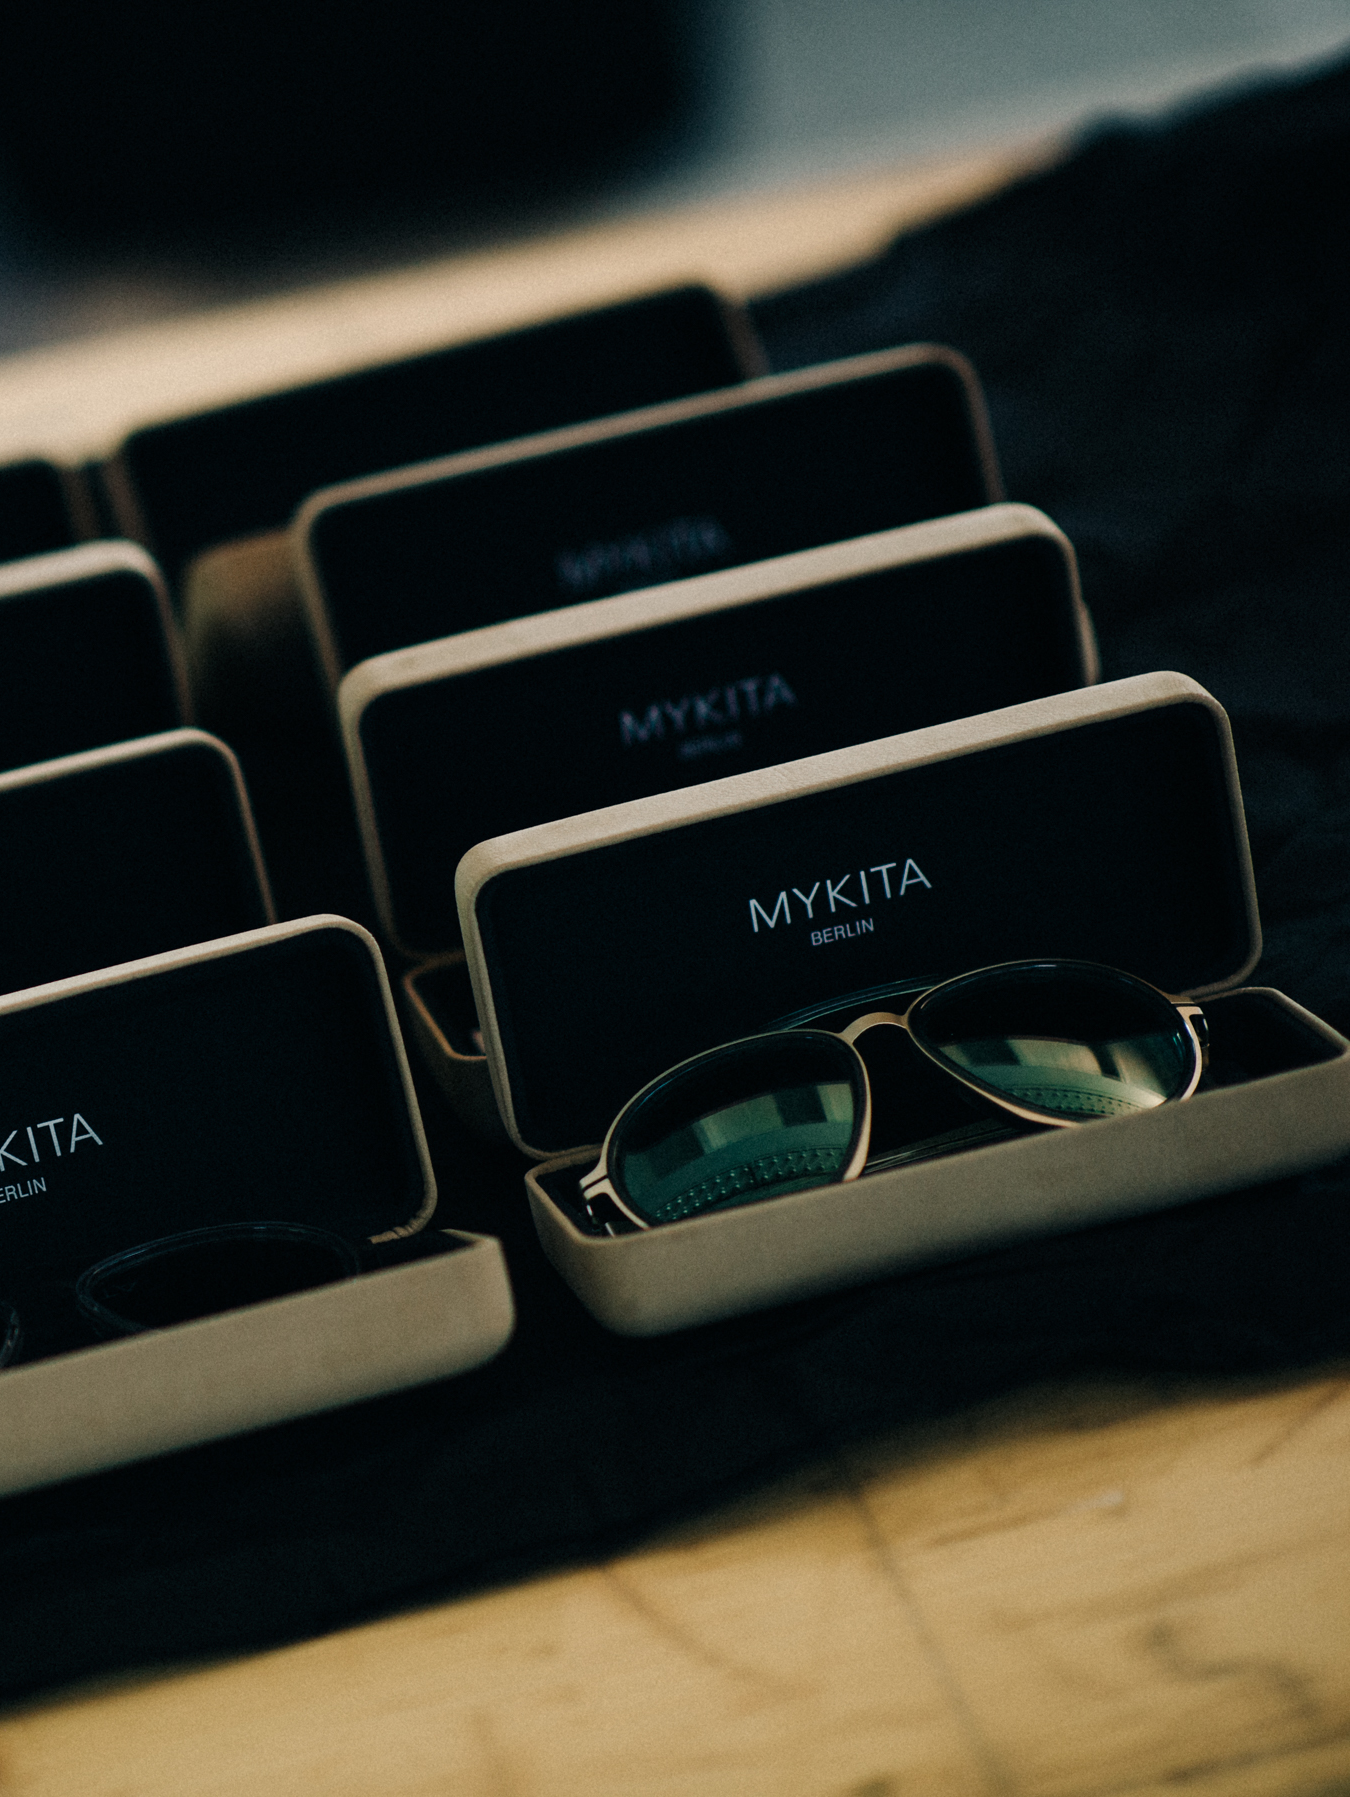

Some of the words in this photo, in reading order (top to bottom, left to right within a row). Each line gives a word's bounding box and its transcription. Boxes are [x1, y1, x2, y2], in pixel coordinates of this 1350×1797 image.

[618, 671, 798, 747] MYKITA
[749, 858, 932, 933] MYKITA
[811, 918, 875, 946] BERLIN
